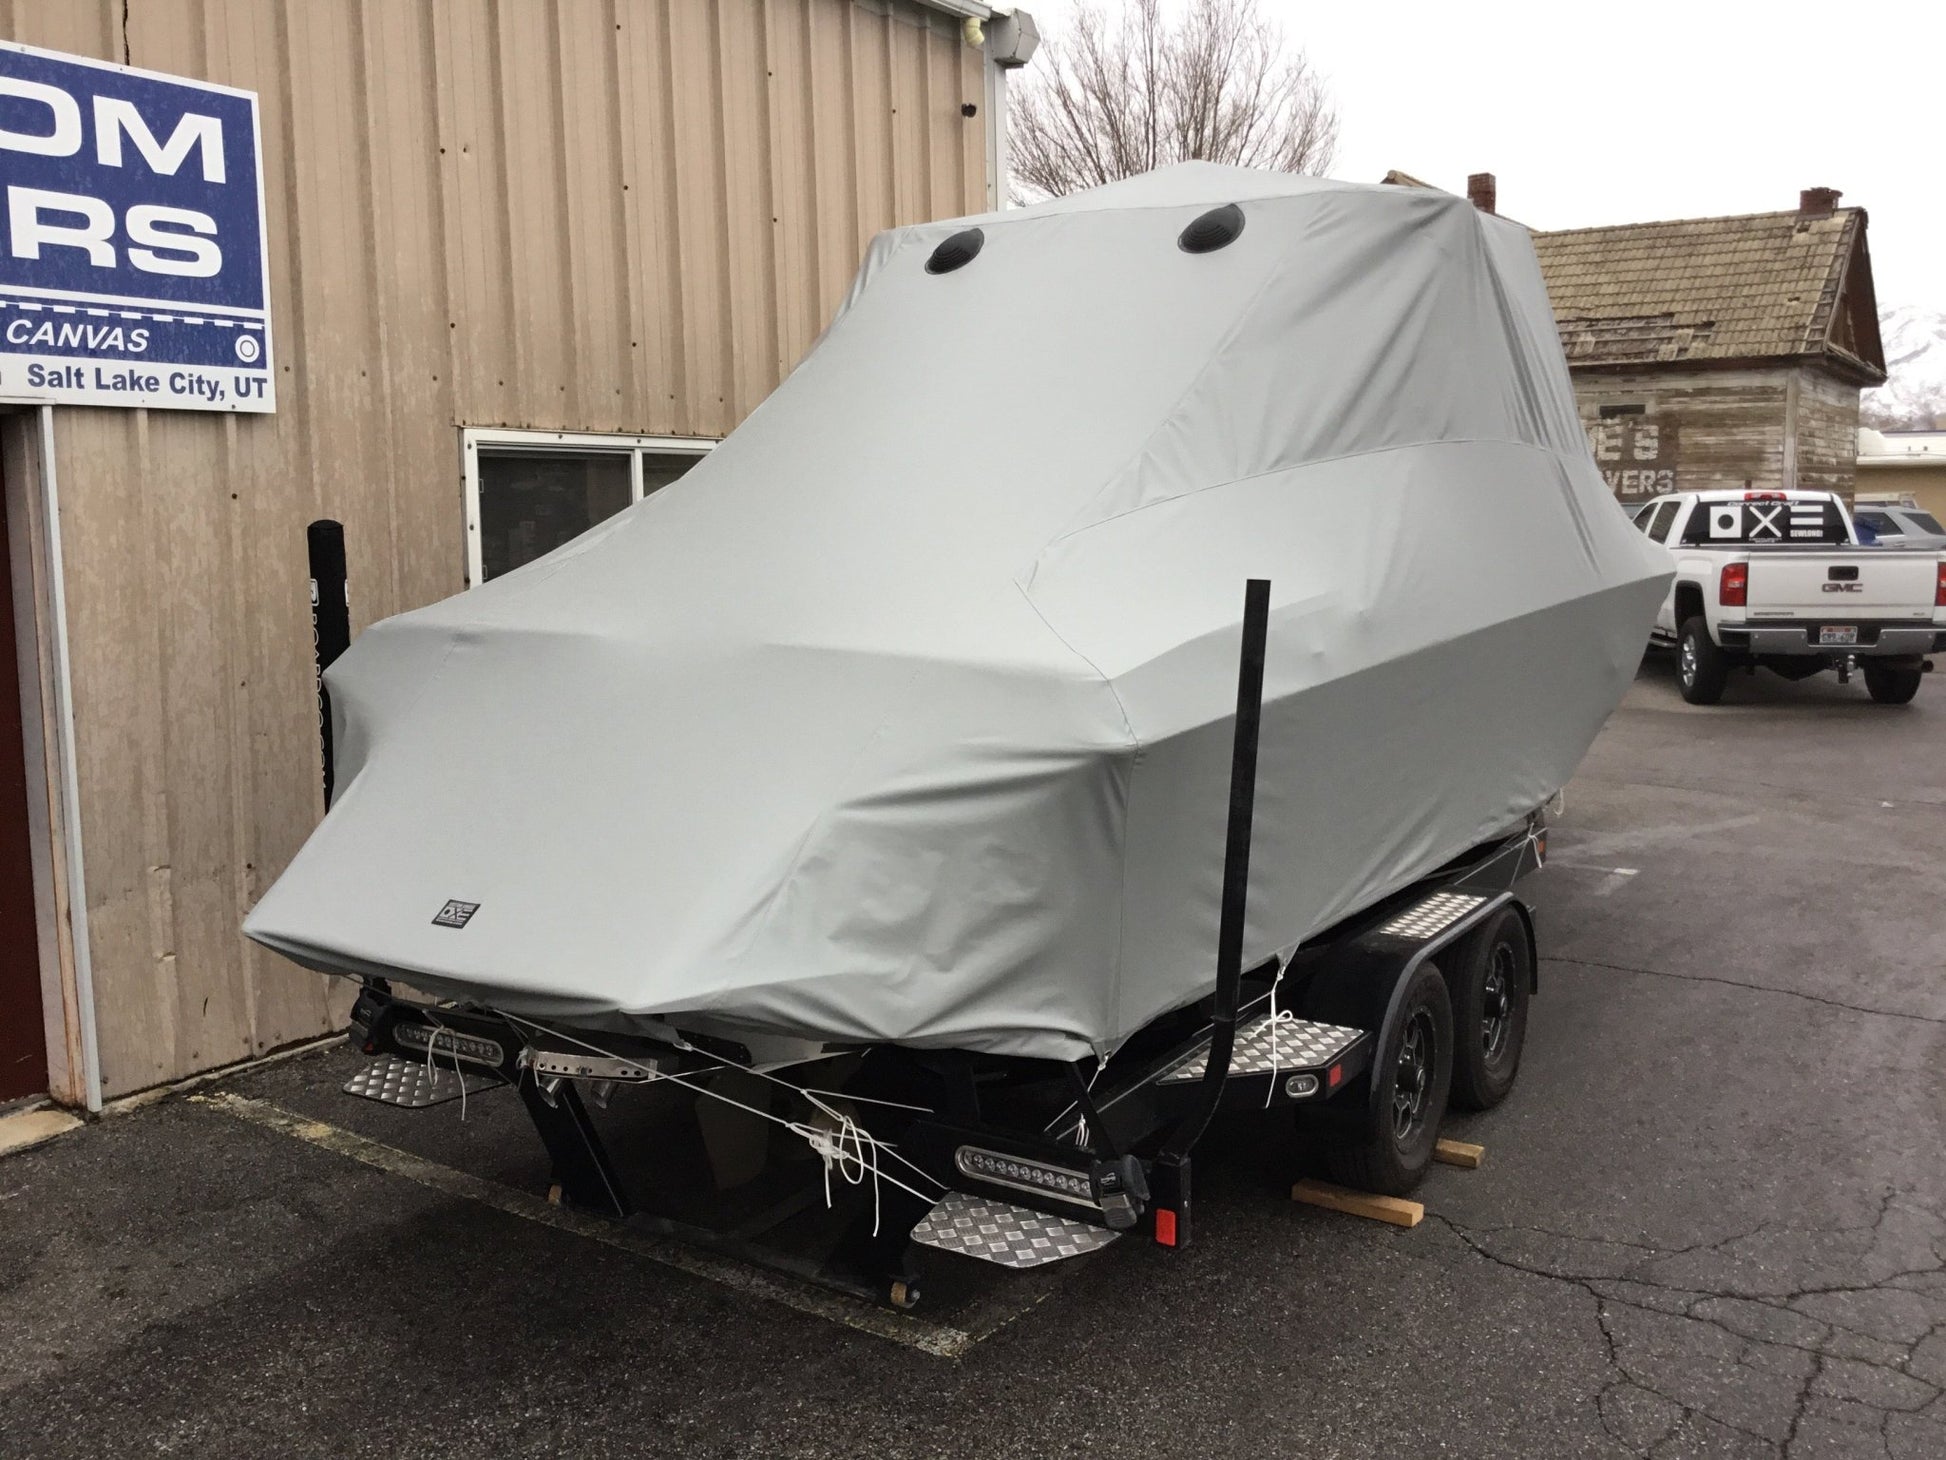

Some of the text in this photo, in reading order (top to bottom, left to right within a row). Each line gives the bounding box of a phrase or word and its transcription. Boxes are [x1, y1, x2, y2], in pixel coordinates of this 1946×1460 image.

[0, 76, 226, 184] OM
[7, 185, 223, 279] RS
[6, 319, 150, 353] CANVAS
[27, 363, 85, 390] Salt
[95, 367, 160, 393] Lake
[169, 372, 225, 402] City,
[234, 376, 268, 399] UT
[1602, 470, 1674, 494] VERS
[1822, 583, 1863, 593] GMC
